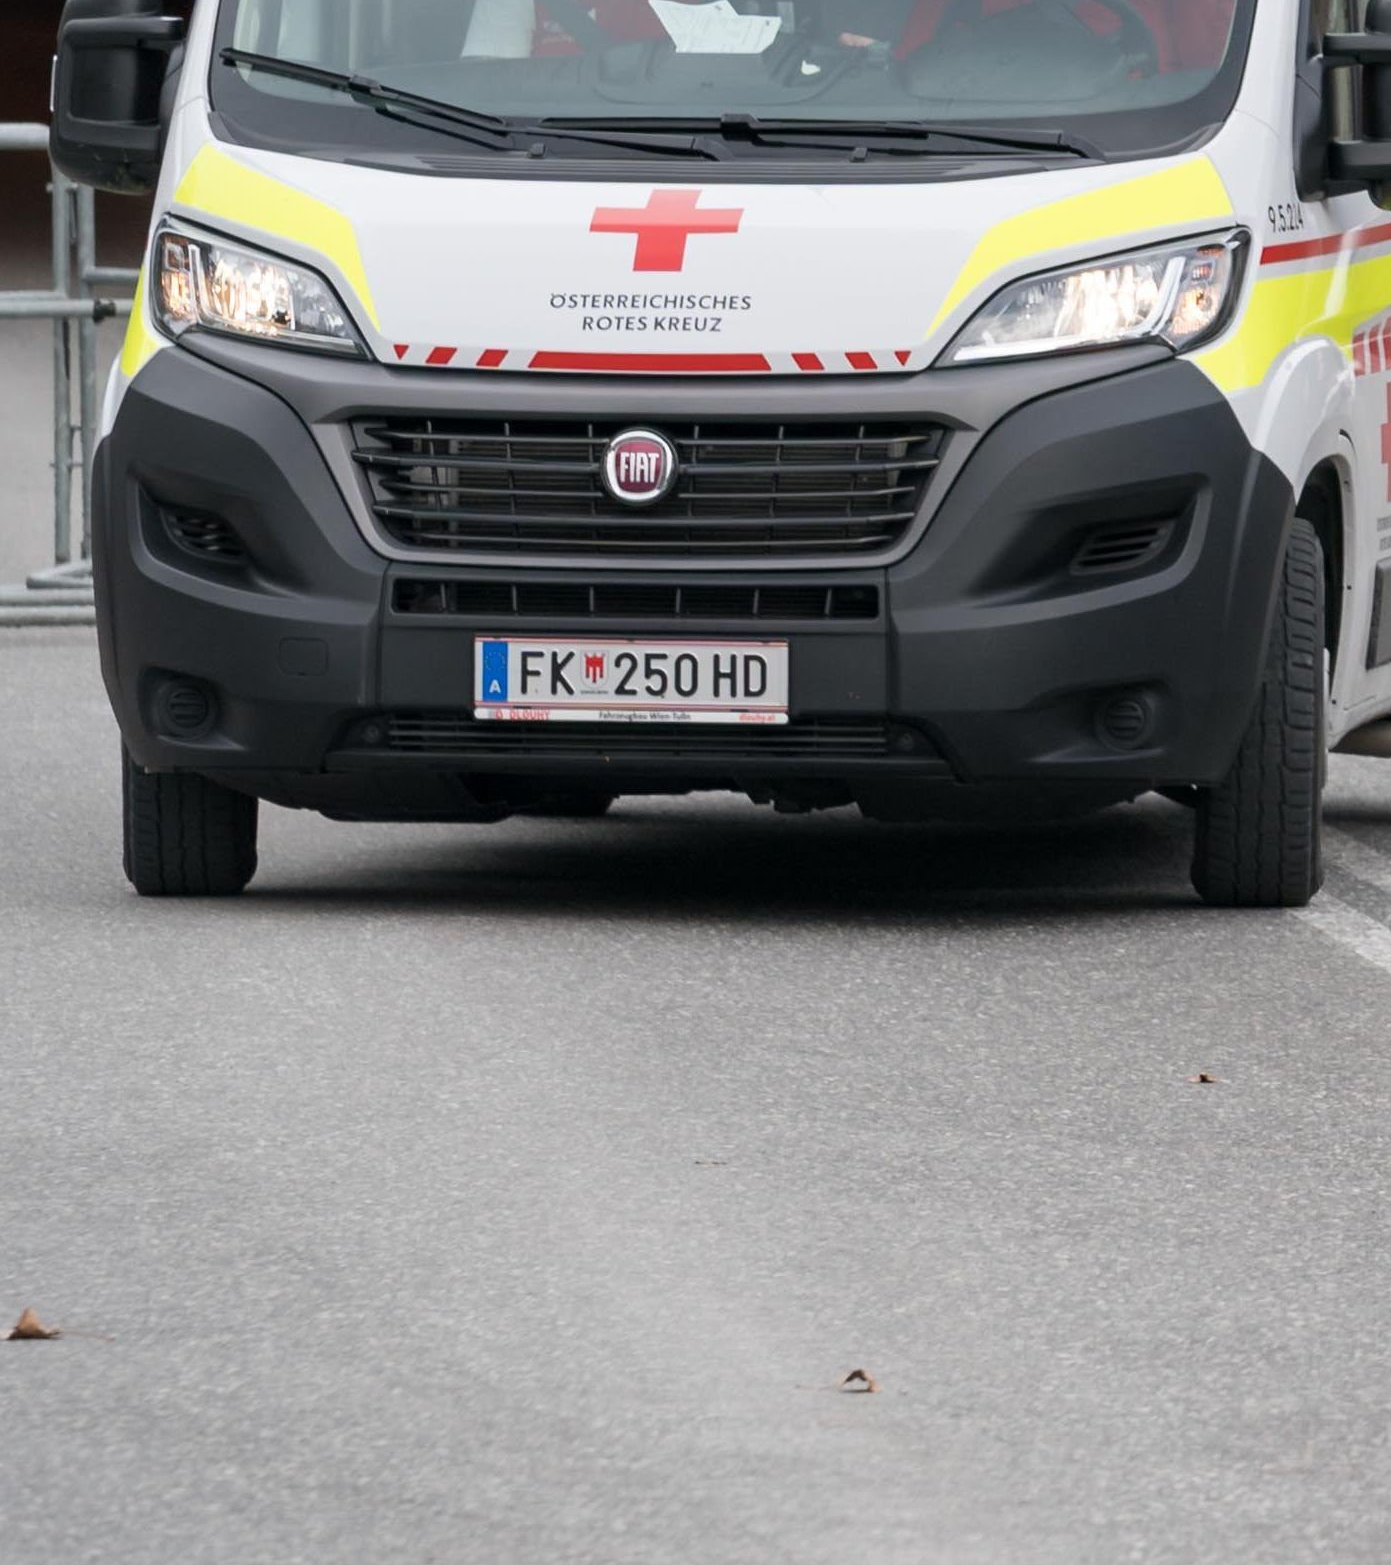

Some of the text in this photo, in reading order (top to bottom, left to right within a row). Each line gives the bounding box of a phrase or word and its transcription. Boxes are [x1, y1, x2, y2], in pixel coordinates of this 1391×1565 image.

[549, 292, 752, 311] ÖSTERREICHISCHES
[581, 315, 723, 333] ROTES KREUZ
[619, 451, 660, 484] FIAT
[489, 650, 768, 698] A FK 250 HD
